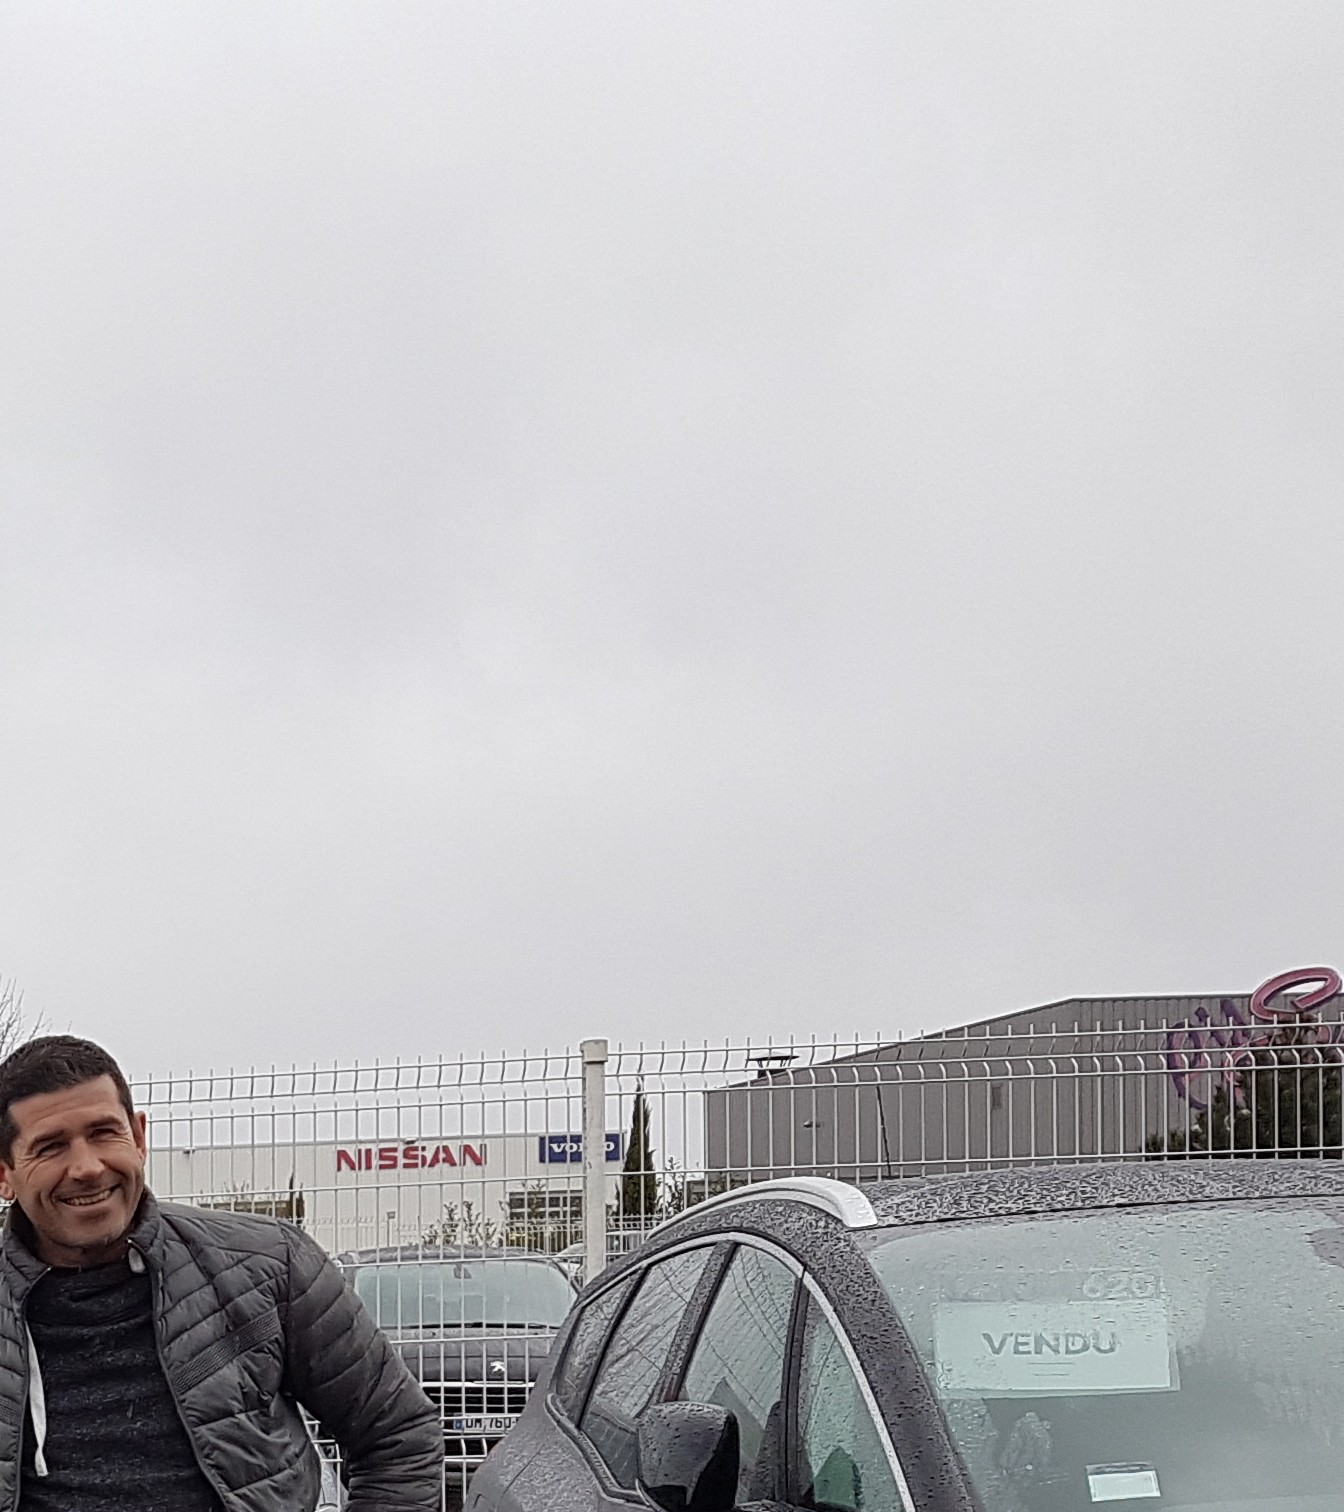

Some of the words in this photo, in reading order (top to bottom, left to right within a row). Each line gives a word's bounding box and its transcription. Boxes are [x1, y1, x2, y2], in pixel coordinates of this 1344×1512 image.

[335, 1143, 488, 1172] NISSAN
[549, 1141, 616, 1154] VOO
[982, 1331, 1120, 1356] VENDU
